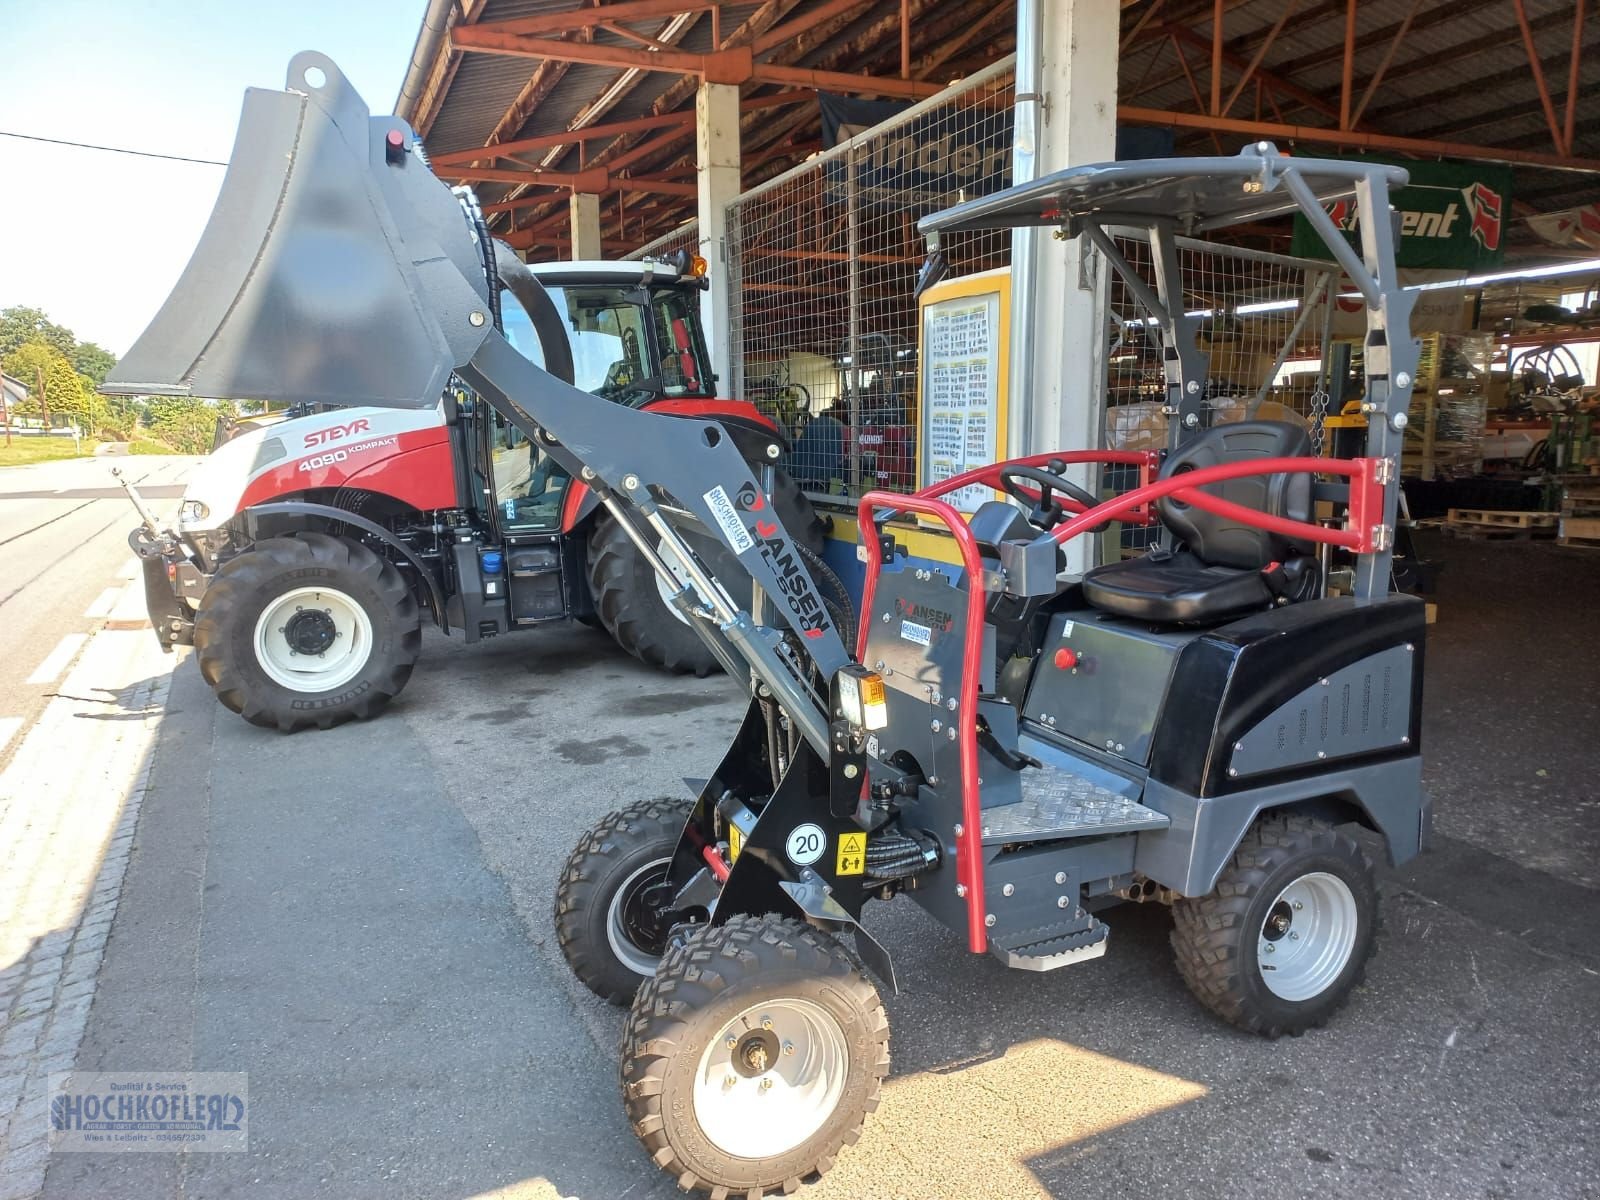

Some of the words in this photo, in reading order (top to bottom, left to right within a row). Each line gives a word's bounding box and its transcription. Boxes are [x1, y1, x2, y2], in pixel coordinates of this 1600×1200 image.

[304, 418, 371, 448] STEYR
[299, 450, 347, 472] 4090
[348, 437, 398, 454] KOMPAKT
[756, 519, 831, 634] JANSEN
[906, 602, 953, 625] JANSEN
[795, 833, 820, 855] 20
